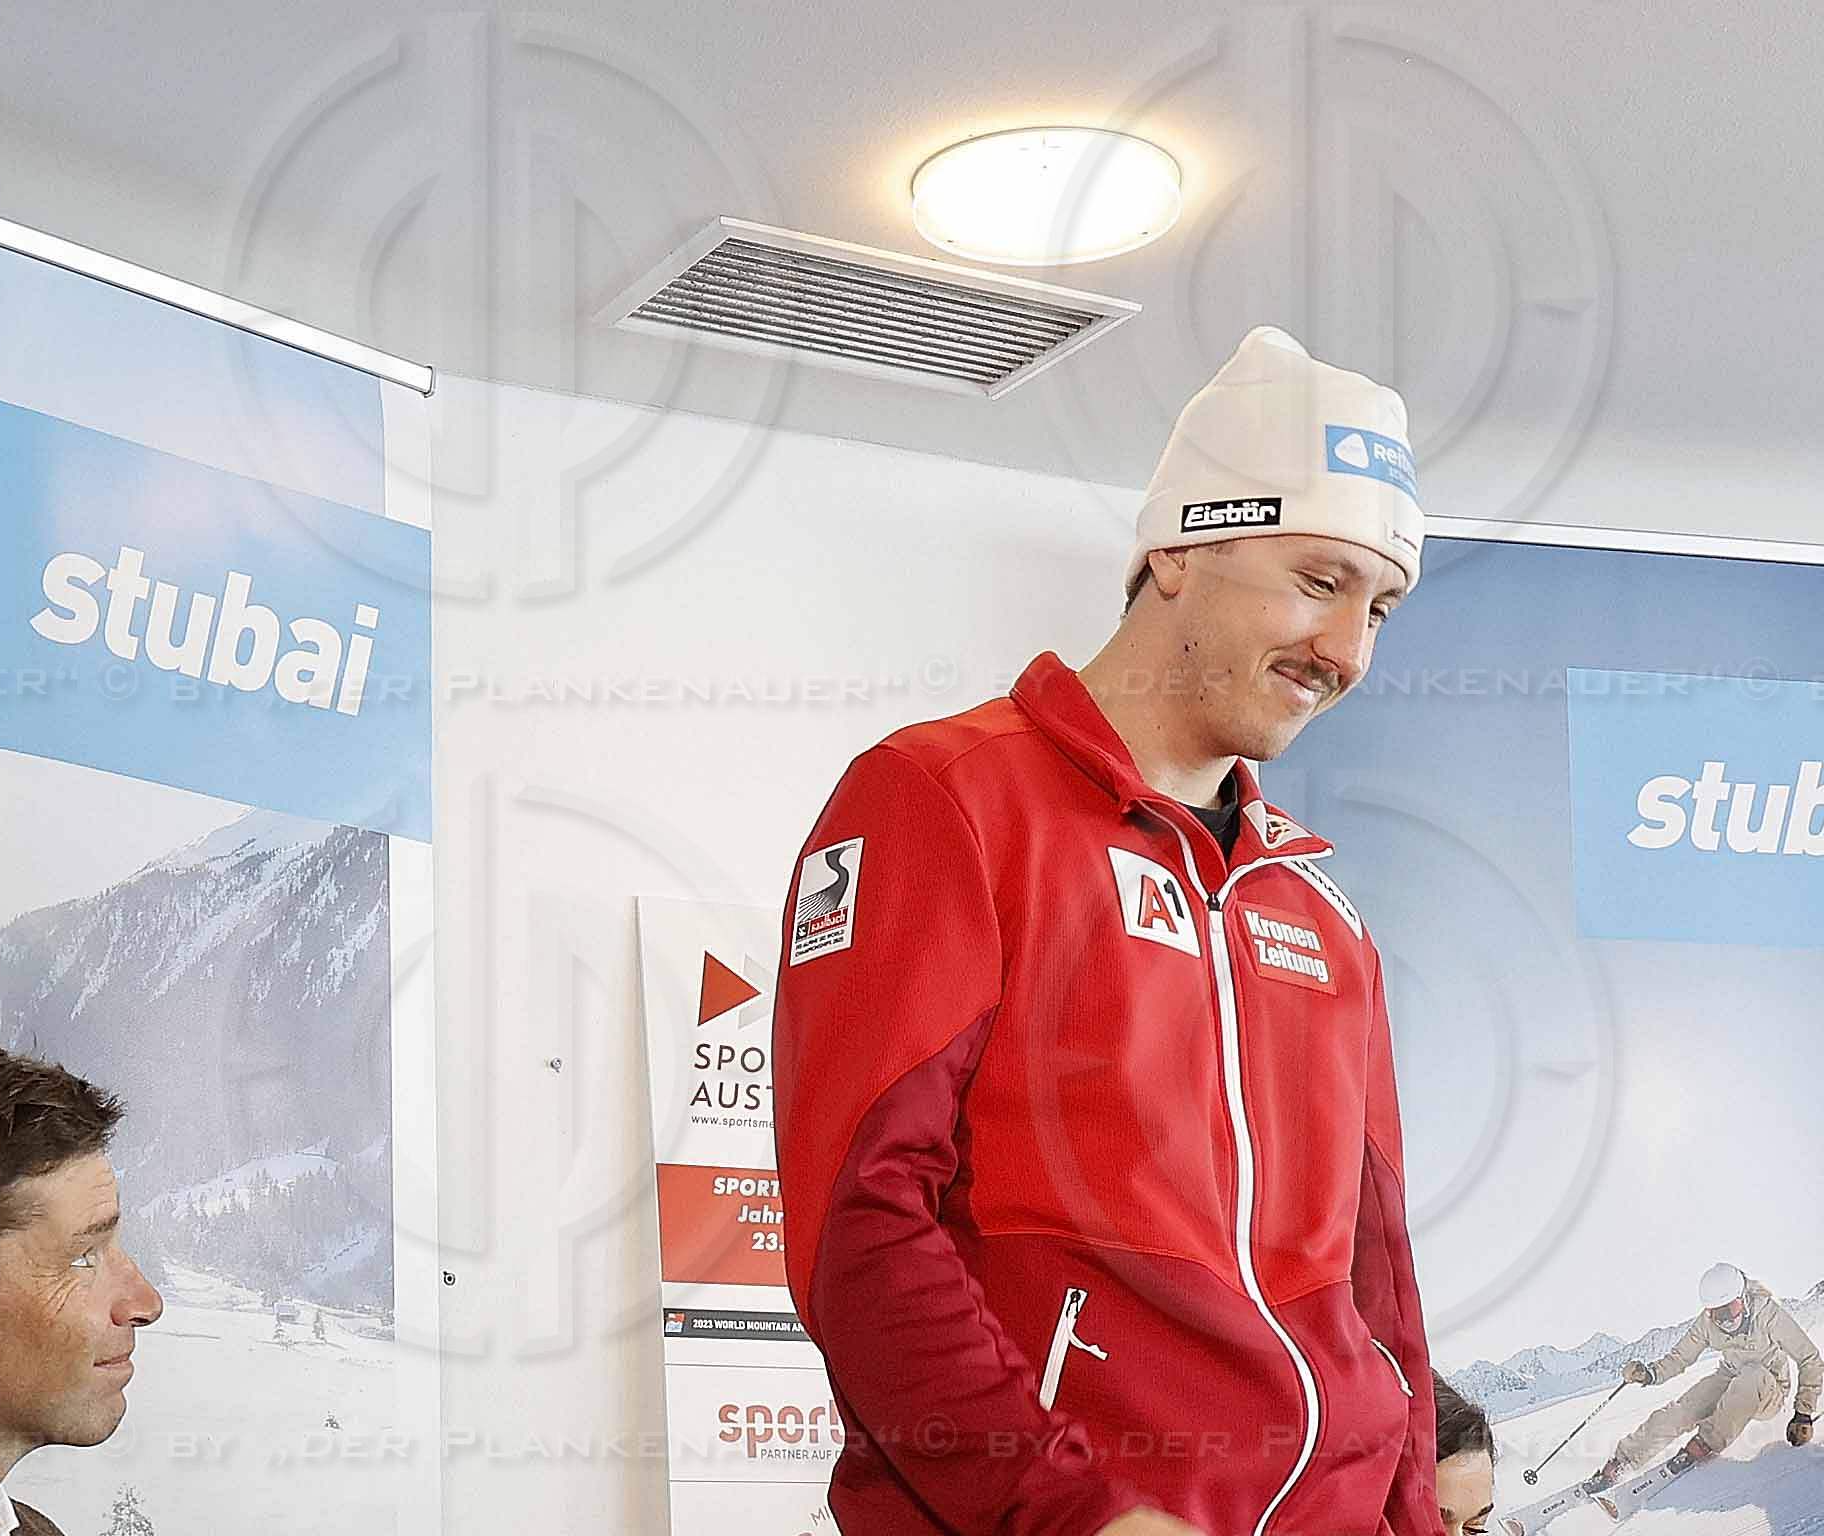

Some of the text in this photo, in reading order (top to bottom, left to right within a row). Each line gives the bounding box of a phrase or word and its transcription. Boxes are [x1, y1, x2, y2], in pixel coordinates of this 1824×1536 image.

[1183, 501, 1276, 528] Eisbär
[29, 545, 380, 717] stubai
[1244, 909, 1322, 952] Kronen
[1253, 939, 1329, 984] Zeitung
[693, 1319, 713, 1329] 2023
[714, 1320, 745, 1330] WORLD
[747, 1321, 791, 1332] MOUNTAIN
[761, 1449, 832, 1460] PARTNER AUF
